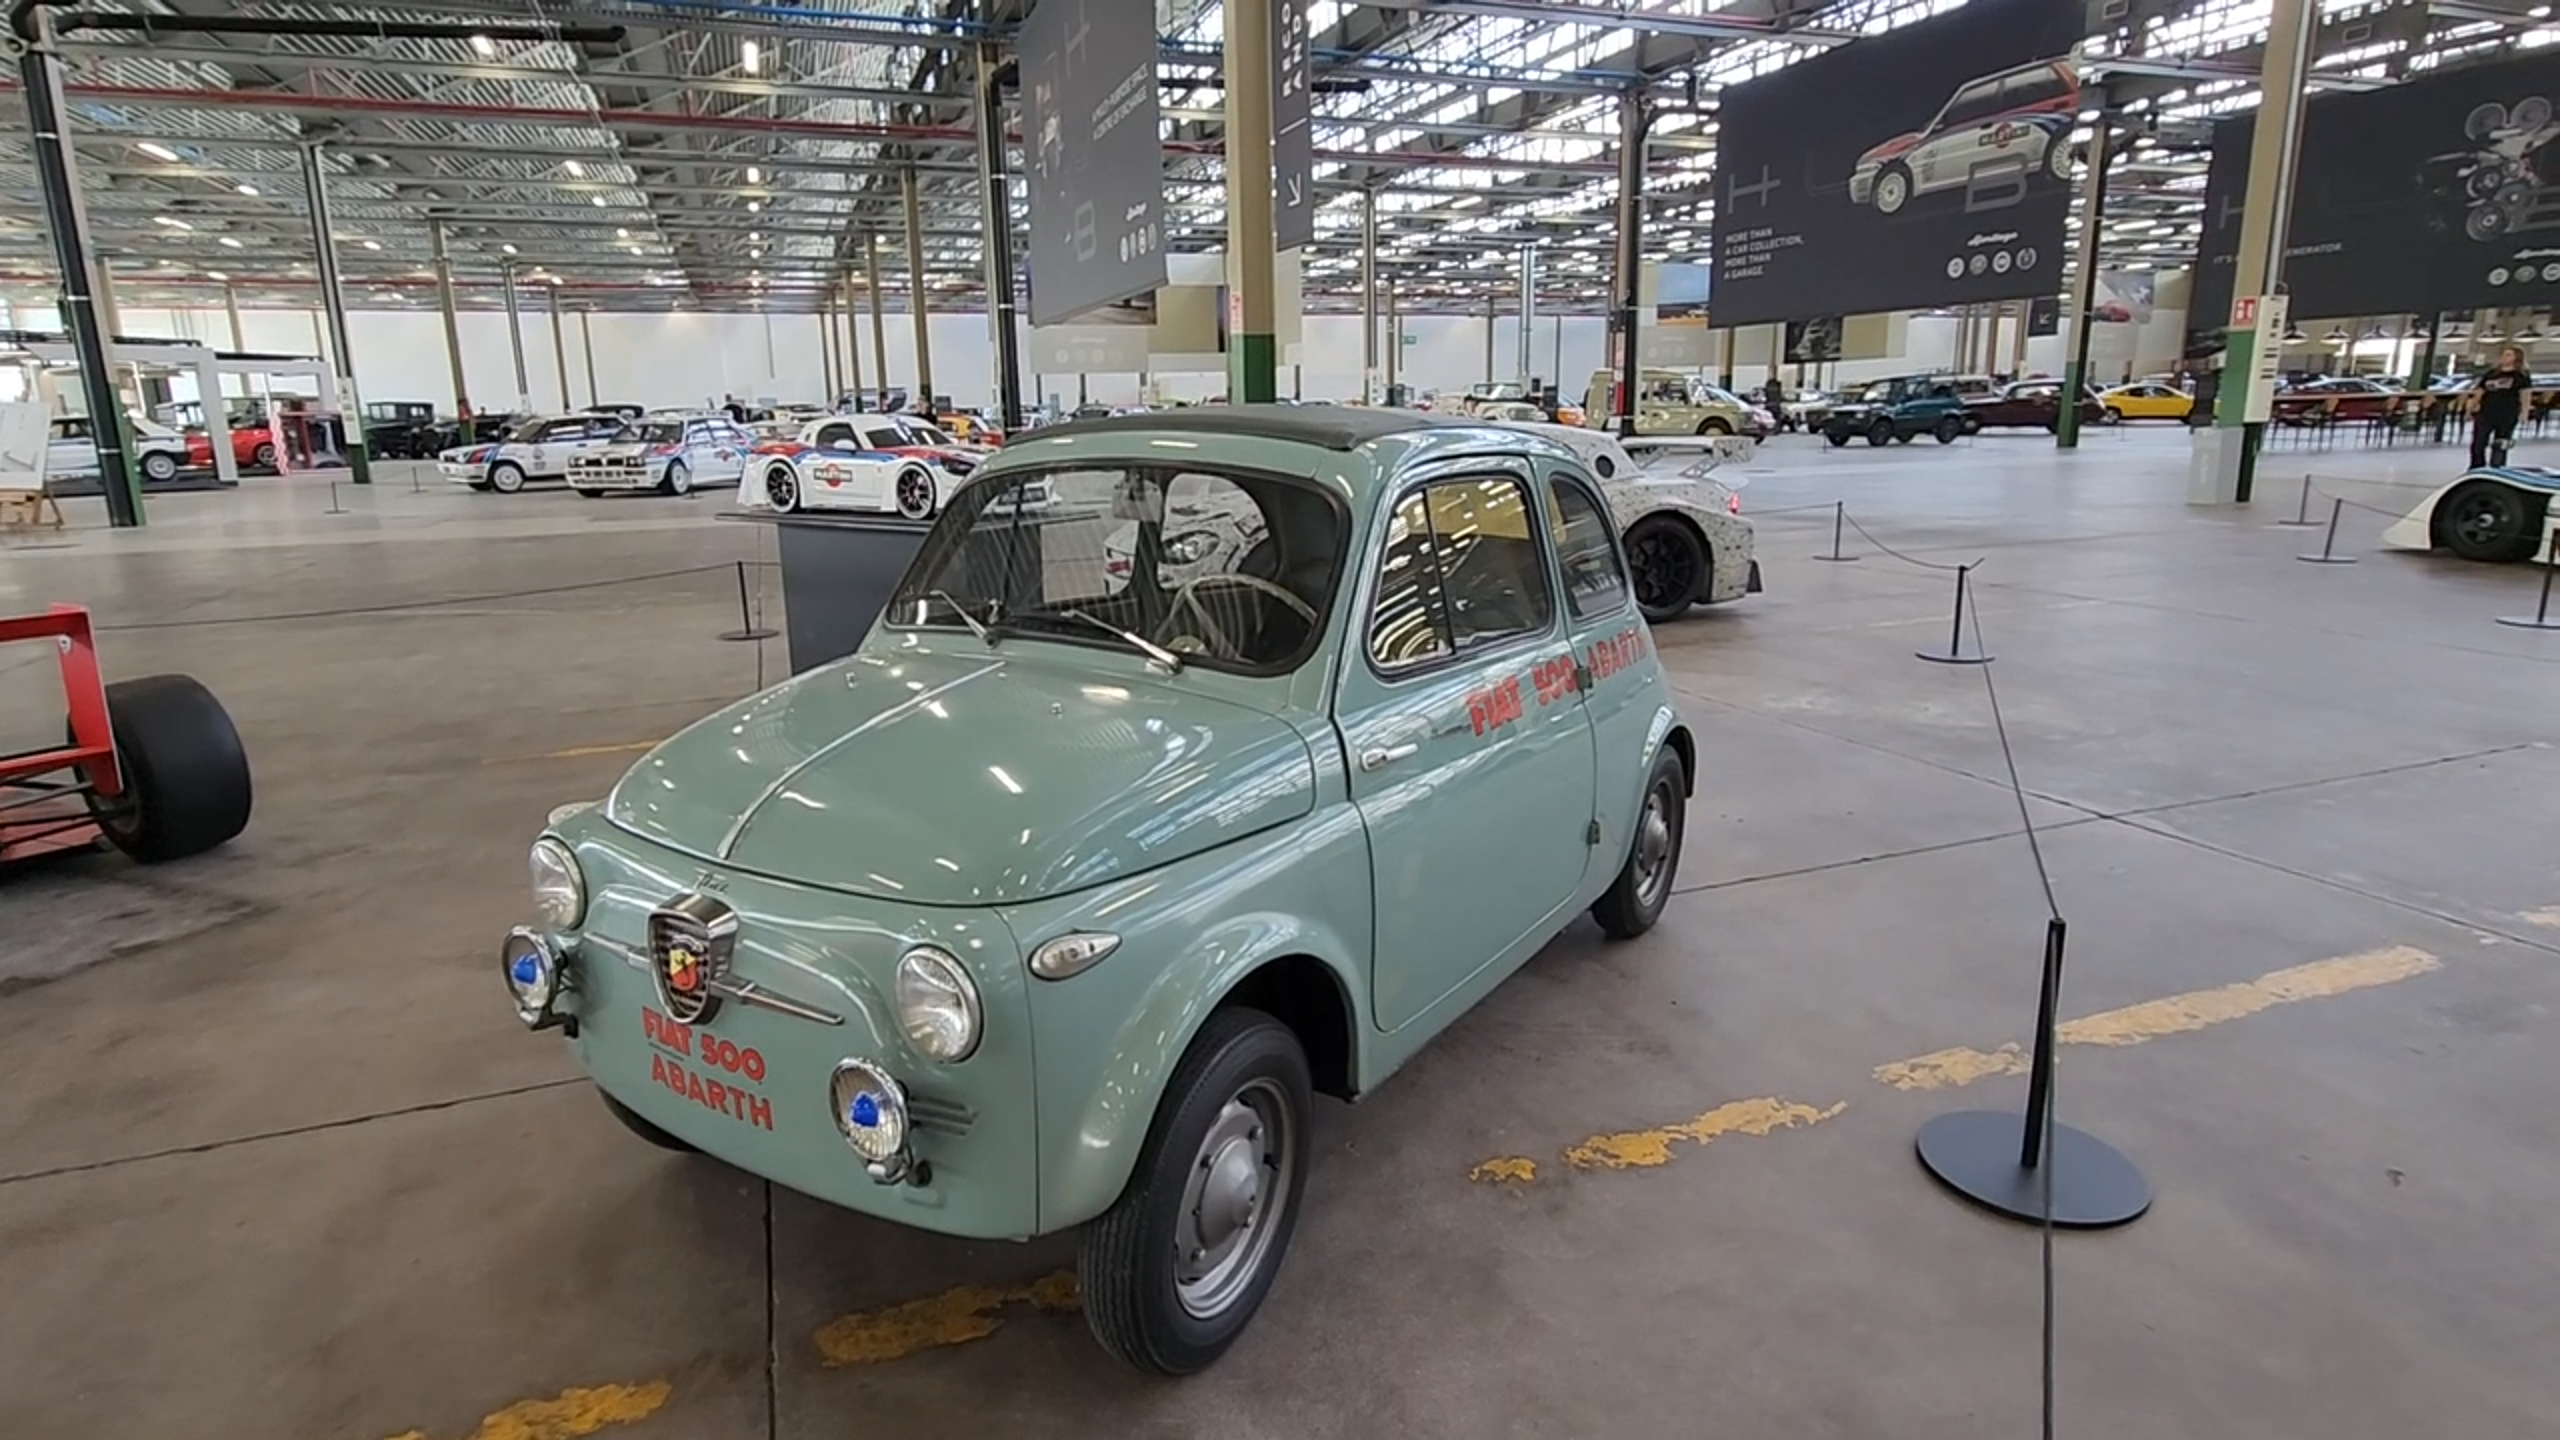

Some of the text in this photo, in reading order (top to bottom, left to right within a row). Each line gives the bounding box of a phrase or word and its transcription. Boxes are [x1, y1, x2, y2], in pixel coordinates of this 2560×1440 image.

[1724, 246, 1732, 256] A
[1732, 243, 1749, 255] CAR
[1725, 227, 1773, 244] MORE THAN
[1724, 252, 1771, 268] MORE THAN
[1464, 628, 1647, 737] FIAT 500 ABARTH
[641, 1005, 766, 1082] FIAT 500
[651, 1053, 774, 1131] ABARTH
